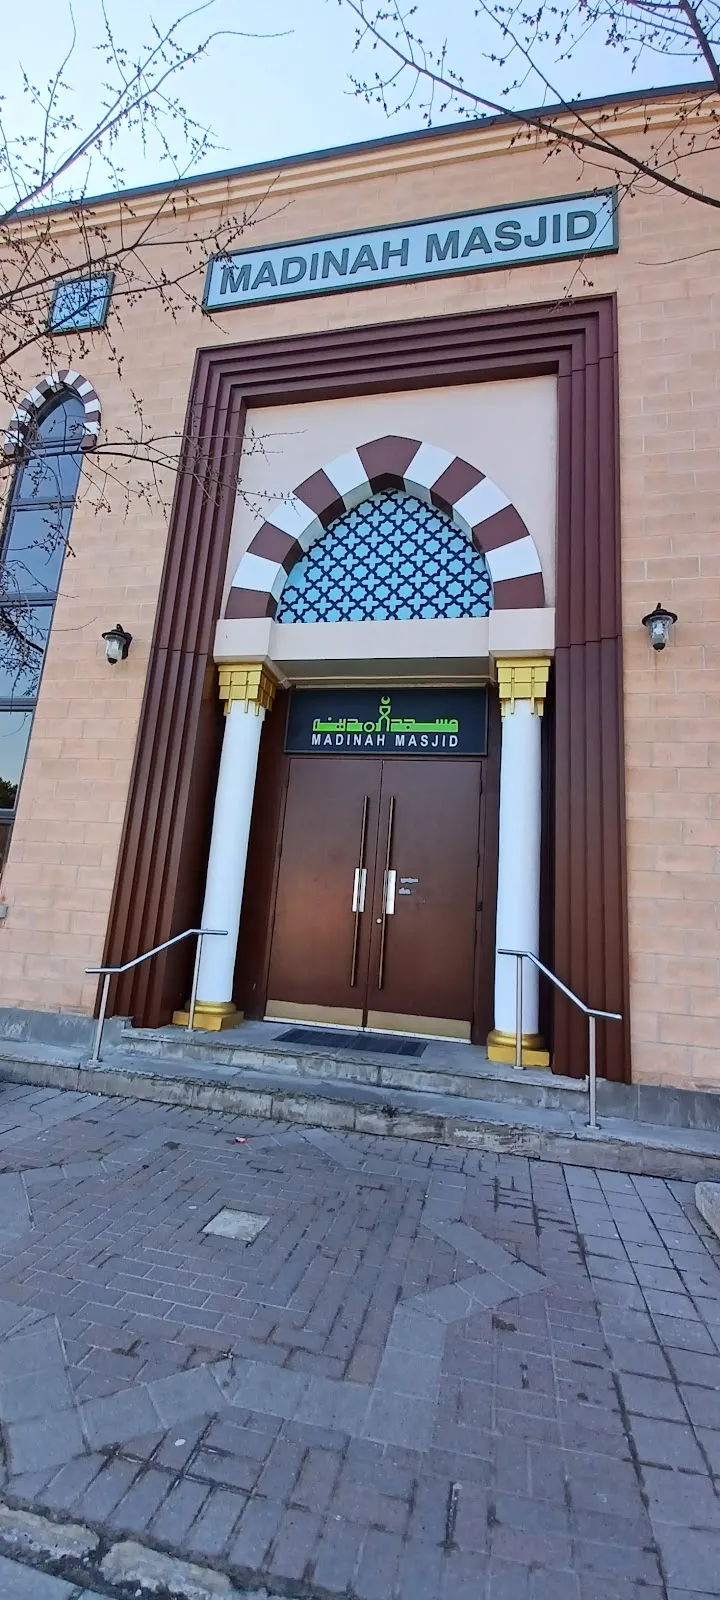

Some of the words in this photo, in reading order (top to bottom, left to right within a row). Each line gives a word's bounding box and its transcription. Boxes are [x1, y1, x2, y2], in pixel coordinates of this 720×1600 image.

[219, 237, 409, 294] MADINAH
[425, 209, 598, 263] MASJID
[311, 733, 386, 747] MADINAH
[395, 734, 458, 748] MASJID
